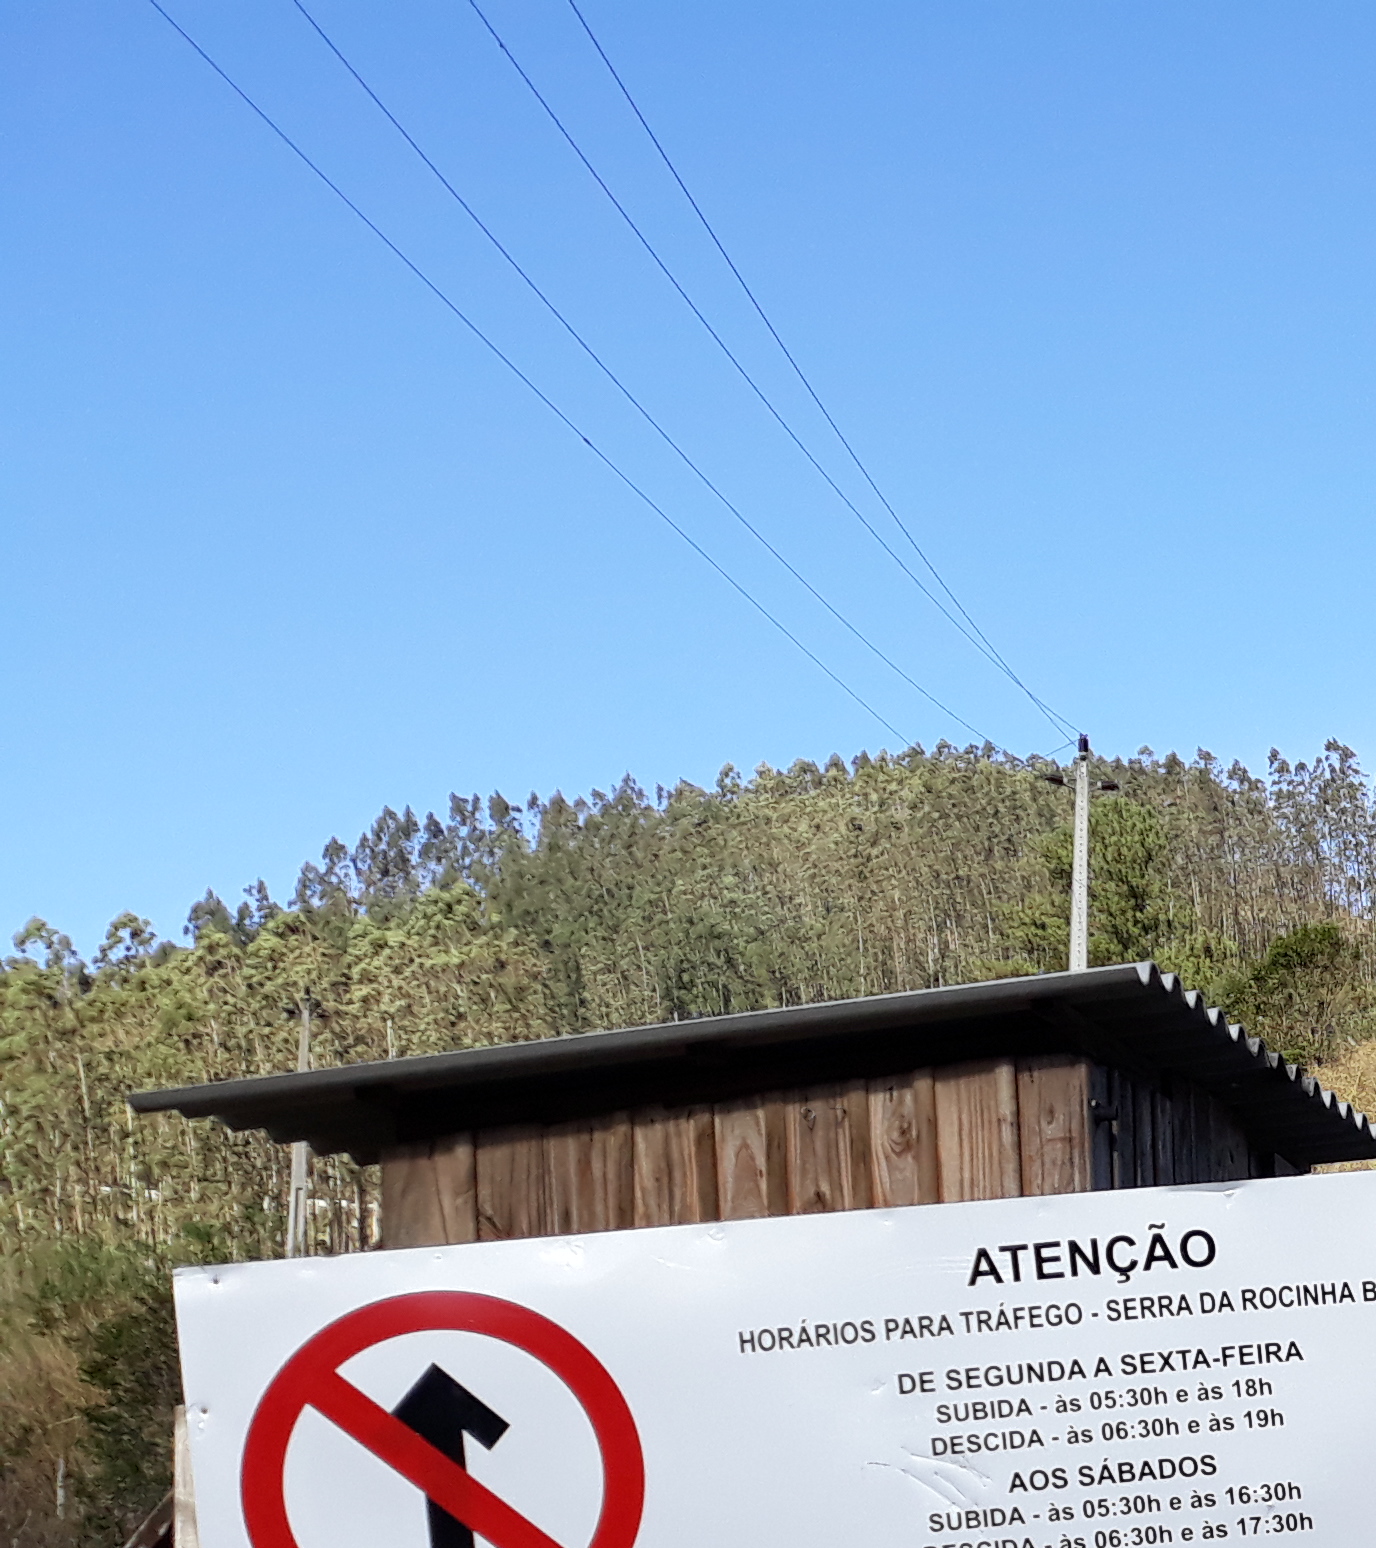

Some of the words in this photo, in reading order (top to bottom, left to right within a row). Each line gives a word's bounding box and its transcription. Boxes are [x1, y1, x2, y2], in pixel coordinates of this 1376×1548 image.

[966, 1221, 1217, 1288] ATENÇÃO
[737, 1319, 877, 1355] HORÁRIOS
[883, 1313, 955, 1342] PARA
[958, 1301, 1084, 1335] TRÁFEGO
[1105, 1293, 1194, 1323] SERRA
[1198, 1289, 1236, 1315] DA
[1240, 1280, 1357, 1312] ROCINHA
[896, 1370, 937, 1396] DE
[945, 1357, 1088, 1392] SEGUNDA
[1092, 1355, 1114, 1379] A
[1119, 1339, 1306, 1377] SEXTA-FEIRA
[935, 1397, 1034, 1425] SUBIDA
[1054, 1393, 1083, 1415] às
[1088, 1385, 1169, 1411] 05:30h
[1174, 1387, 1190, 1404] e
[1196, 1381, 1225, 1403] às
[1230, 1376, 1274, 1399] 18h
[930, 1428, 1046, 1458] DESCIDA
[1066, 1428, 1095, 1446] às
[1100, 1416, 1180, 1442] 06:30h
[1186, 1418, 1201, 1435] e
[1207, 1411, 1236, 1434] às
[1242, 1407, 1285, 1430] 19h
[1007, 1466, 1070, 1494] AOS
[1077, 1453, 1218, 1488] SÁBADOS
[928, 1505, 1027, 1534] SUBIDA
[1047, 1505, 1076, 1523] às
[1081, 1493, 1162, 1520] 05:30h
[1168, 1495, 1183, 1512] e
[1189, 1489, 1218, 1510] às
[1223, 1480, 1303, 1507] 16:30h
[1179, 1526, 1195, 1543] e
[1201, 1519, 1229, 1541] às
[1235, 1511, 1314, 1537] 17:30h
